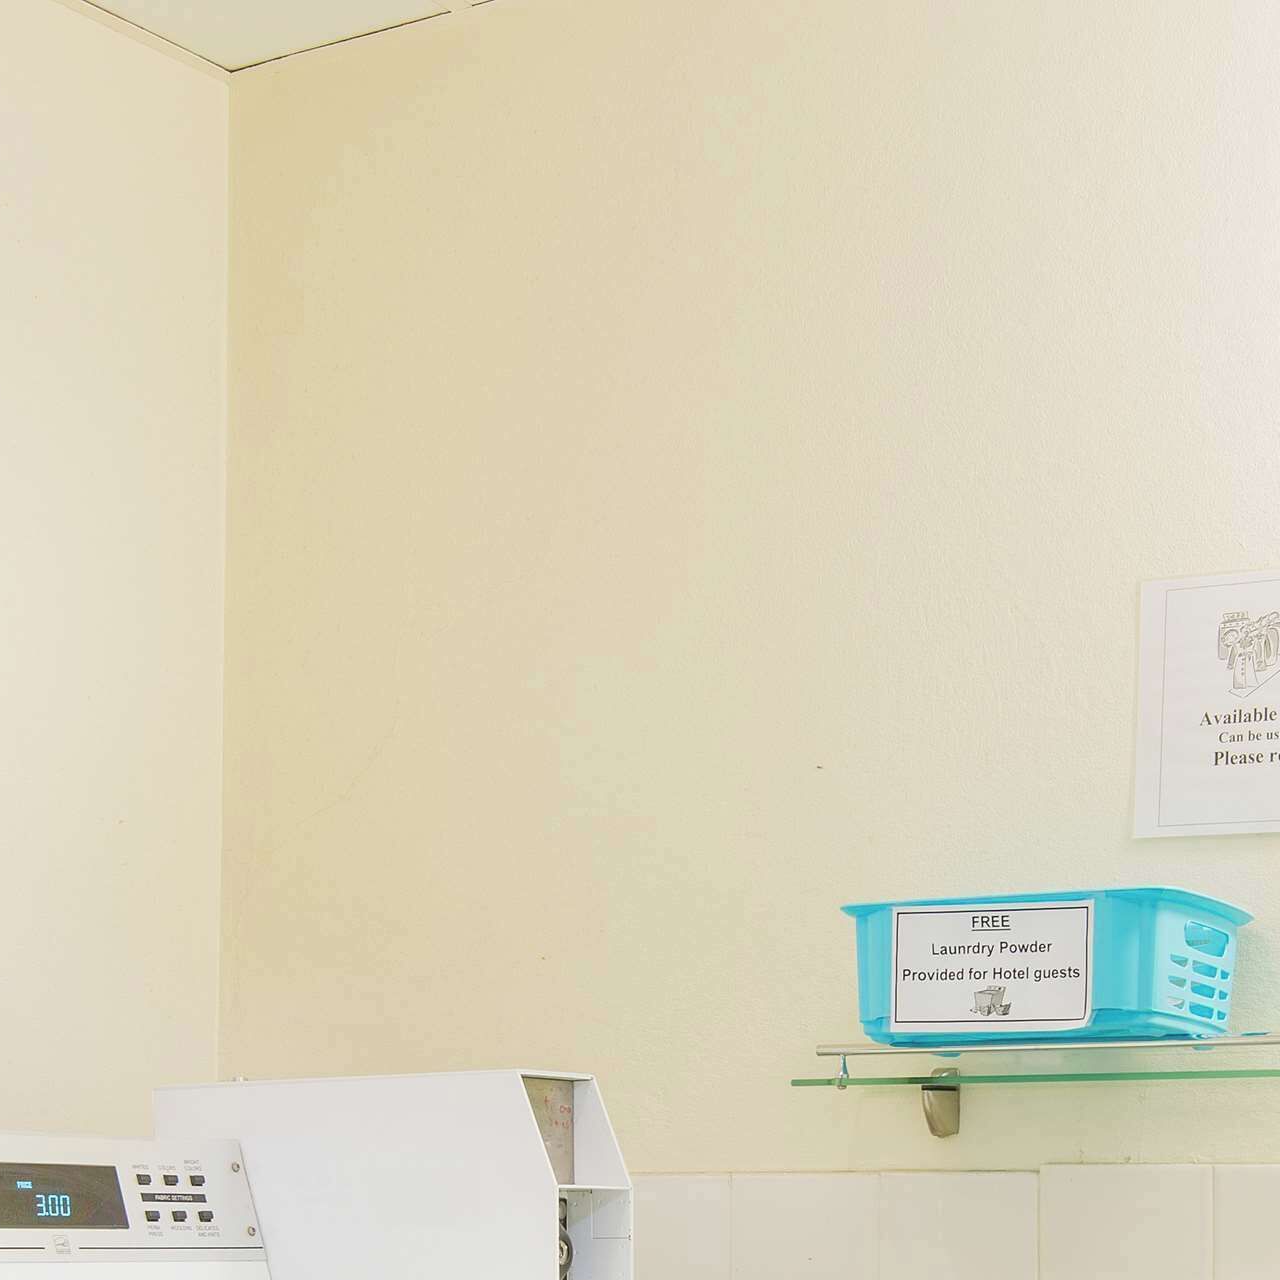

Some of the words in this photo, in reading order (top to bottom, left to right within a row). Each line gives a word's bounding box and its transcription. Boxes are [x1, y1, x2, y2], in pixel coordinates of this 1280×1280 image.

[1200, 708, 1277, 727] Available
[1219, 731, 1243, 743] Can
[1248, 728, 1262, 741] be
[1214, 750, 1264, 766] Please
[972, 915, 1010, 928] FREE
[931, 942, 994, 956] Launrdry
[1000, 941, 1052, 954] Powder
[902, 968, 964, 982] Provided
[969, 967, 987, 980] for
[992, 966, 1029, 980] Hotel
[1034, 966, 1080, 981] guests
[35, 1195, 71, 1216] 3.00
